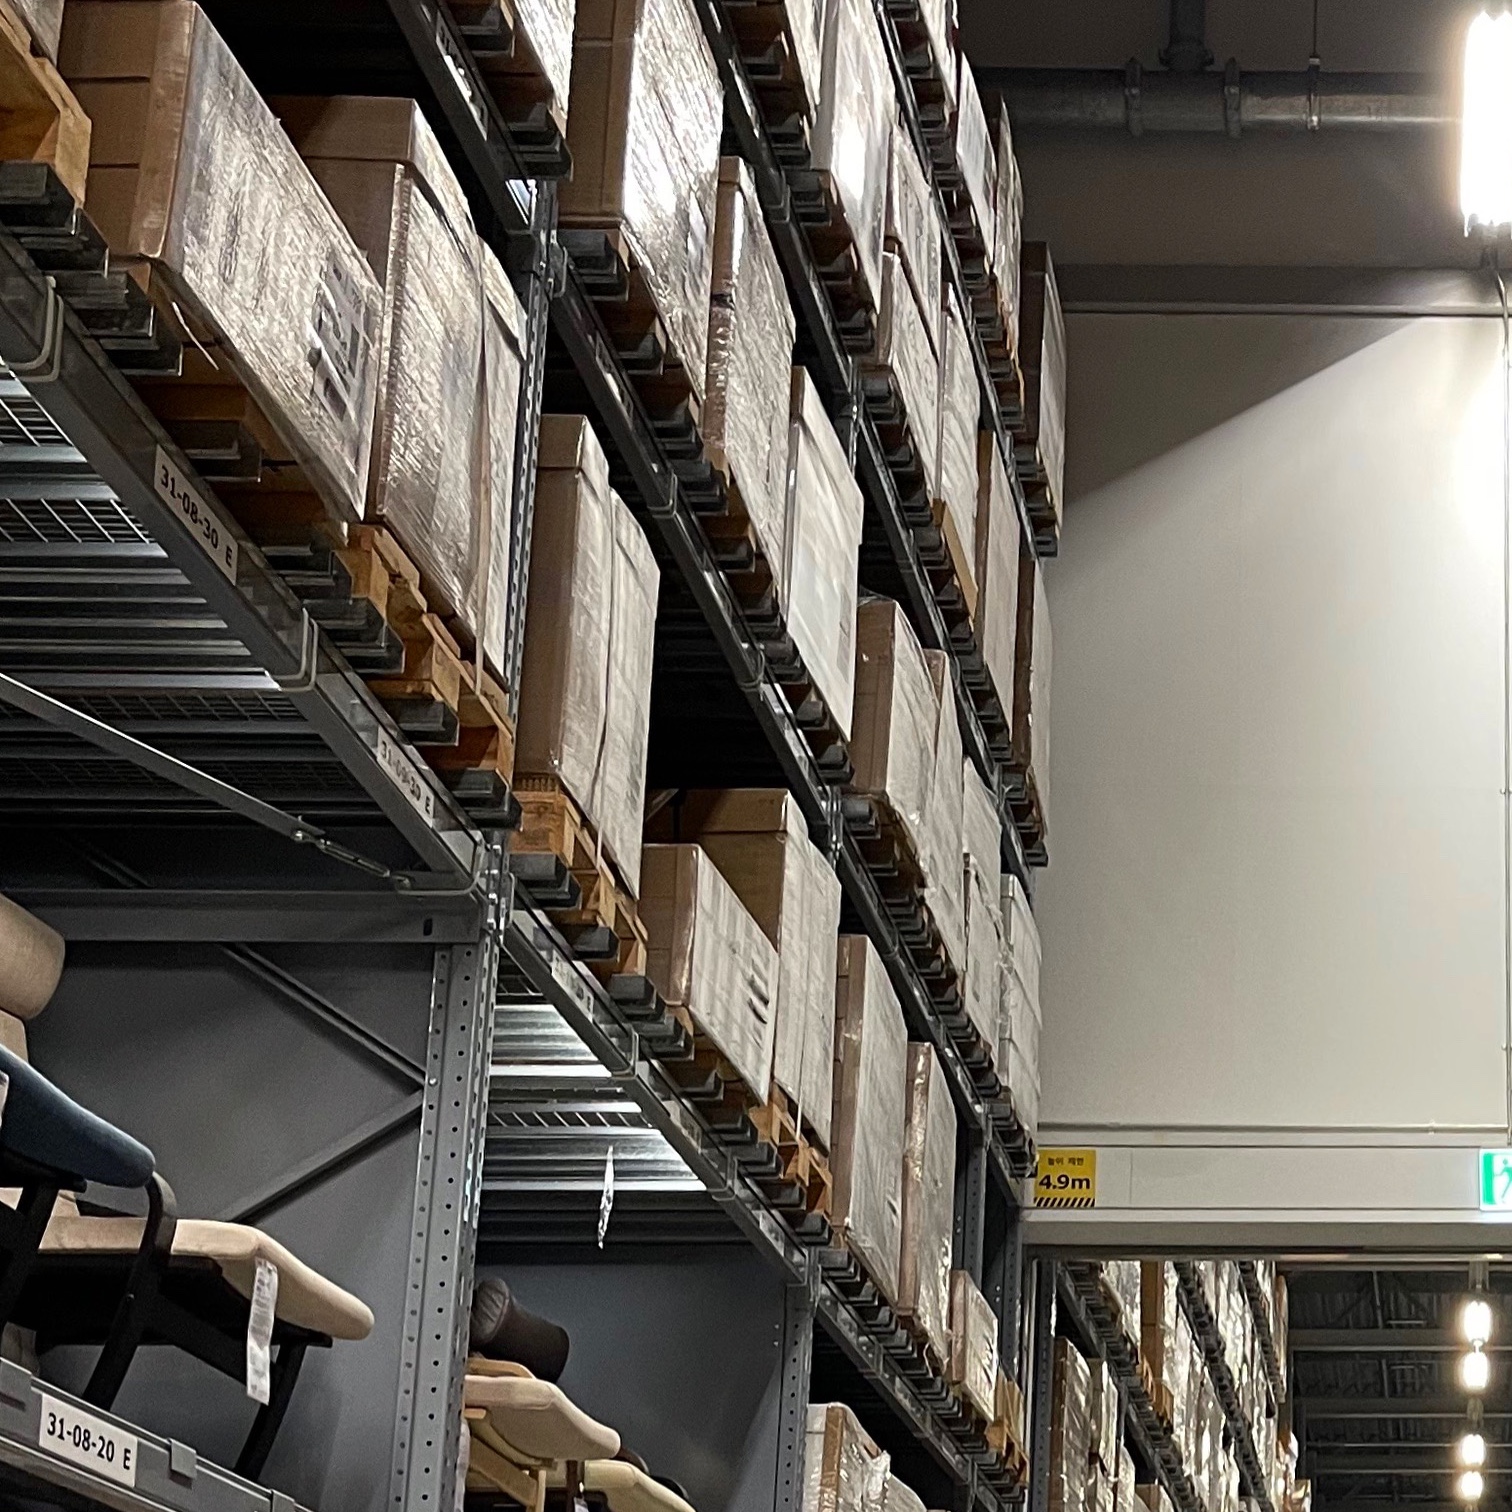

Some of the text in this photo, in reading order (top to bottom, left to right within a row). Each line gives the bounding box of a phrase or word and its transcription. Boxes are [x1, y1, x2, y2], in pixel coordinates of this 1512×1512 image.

[160, 465, 233, 569] 31-08-30 E
[1038, 1174, 1090, 1190] 4.9m
[46, 1412, 131, 1470] 31-08-20 E
